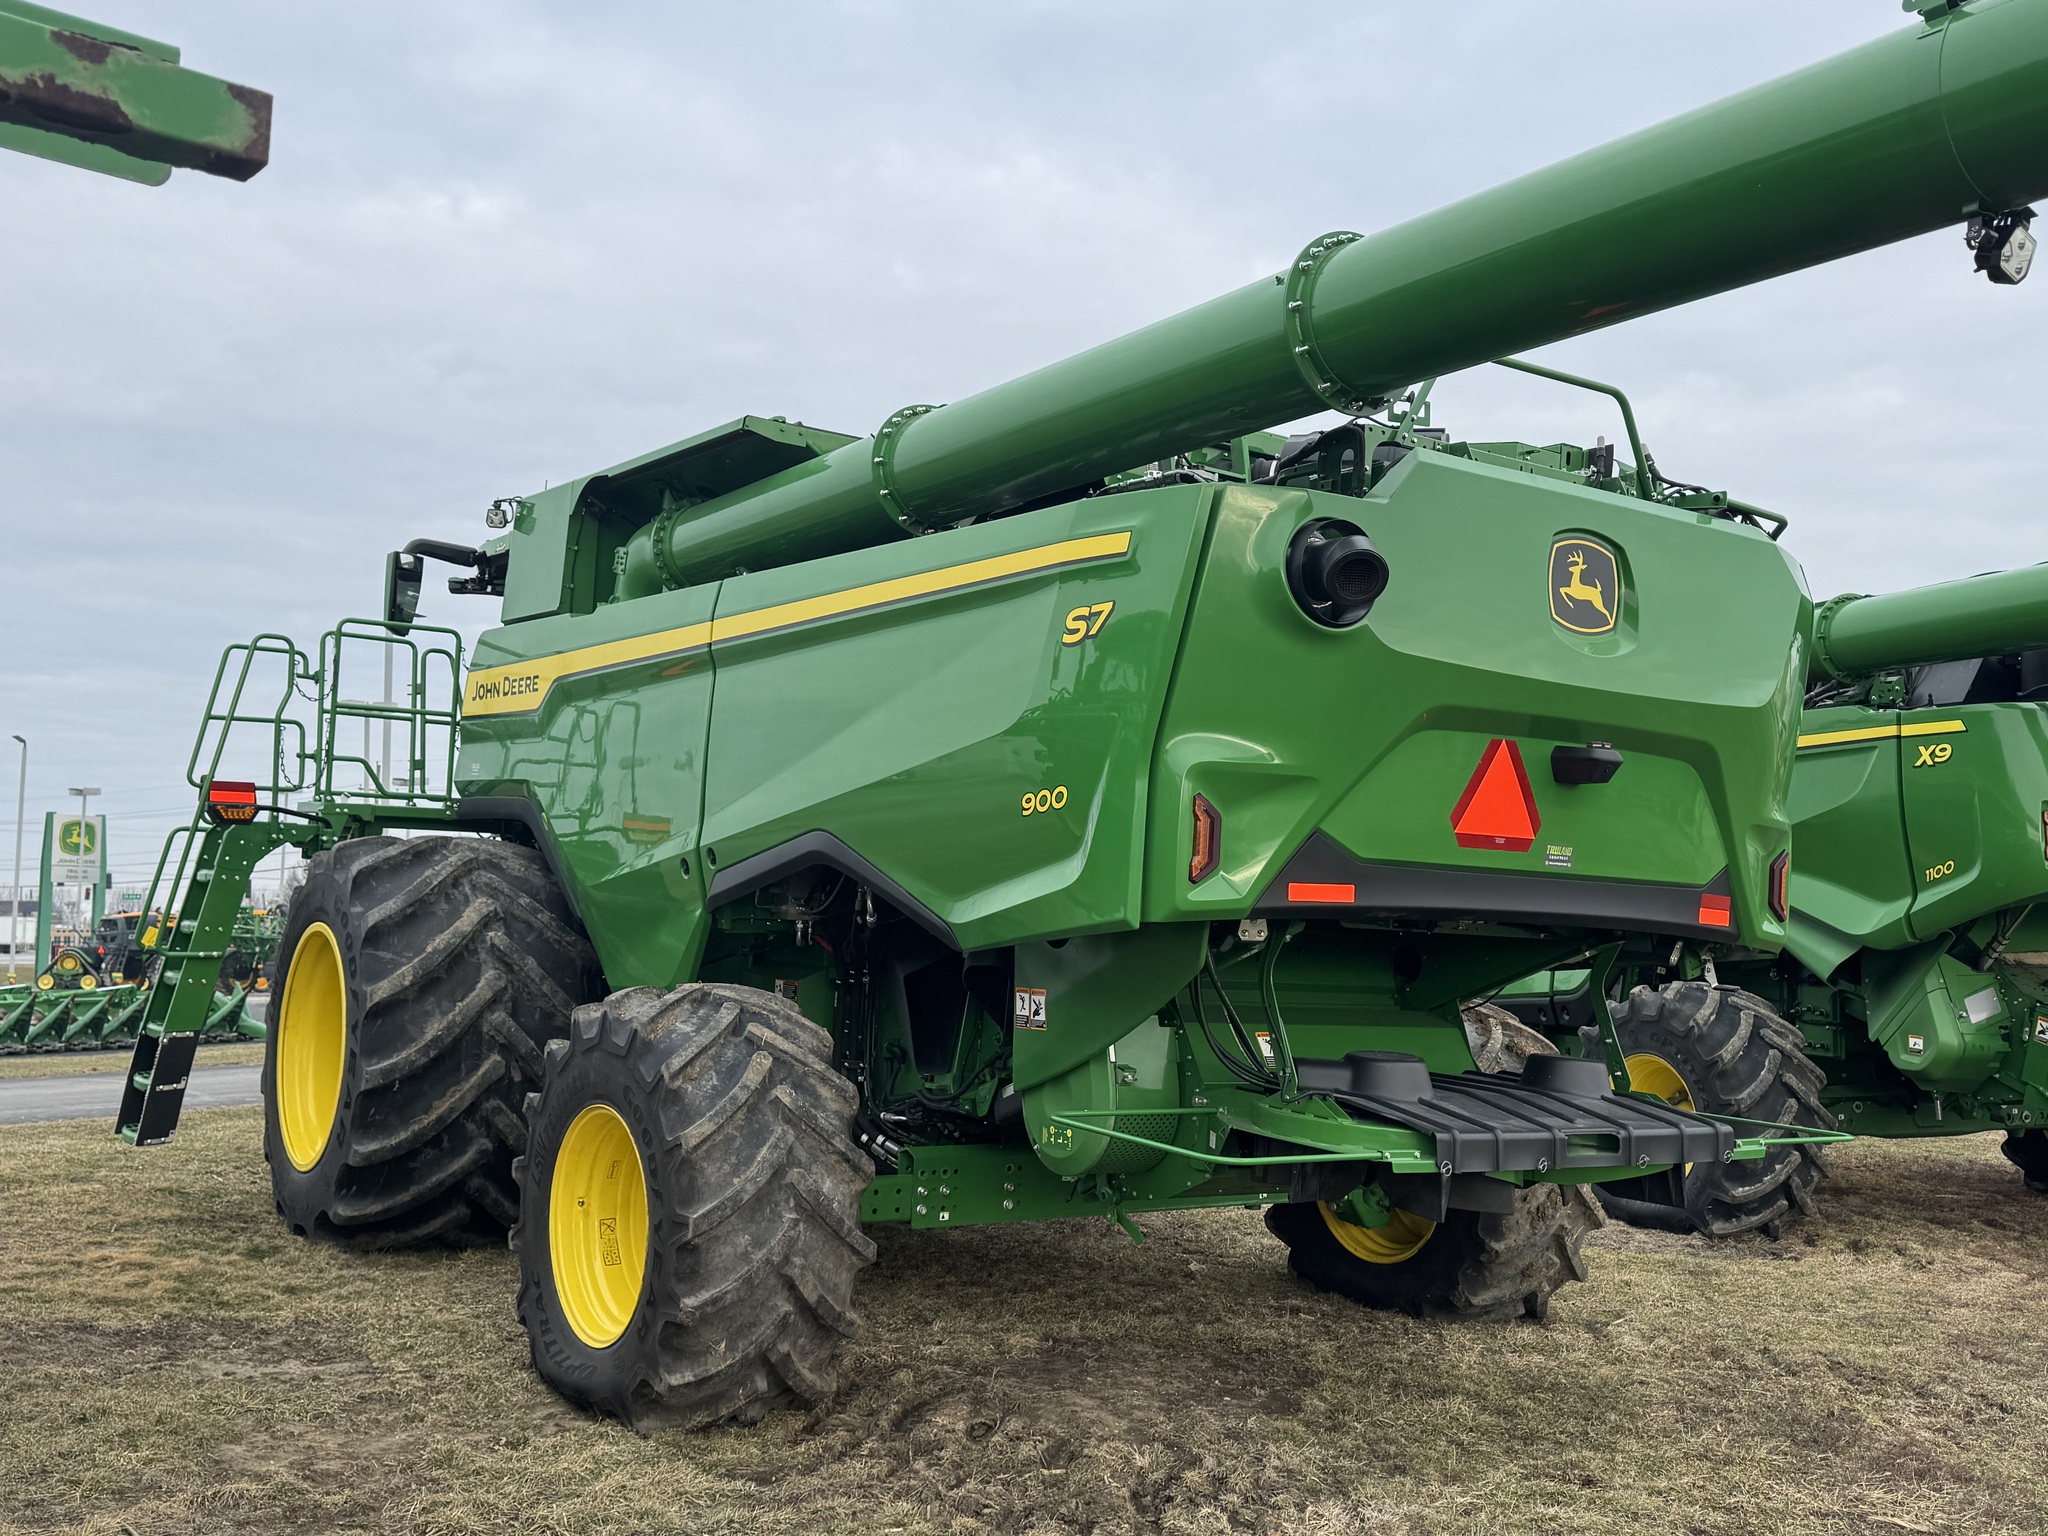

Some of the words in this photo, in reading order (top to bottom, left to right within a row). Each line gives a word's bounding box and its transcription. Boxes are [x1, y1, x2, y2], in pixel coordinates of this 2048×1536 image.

[1061, 600, 1116, 648] S7
[472, 681, 500, 701] JOHN
[503, 675, 539, 697] DEERE
[1913, 743, 1953, 768] X9
[1021, 785, 1068, 817] 900
[1925, 860, 1955, 882] 1100
[531, 1270, 598, 1380] OPTITRAC
